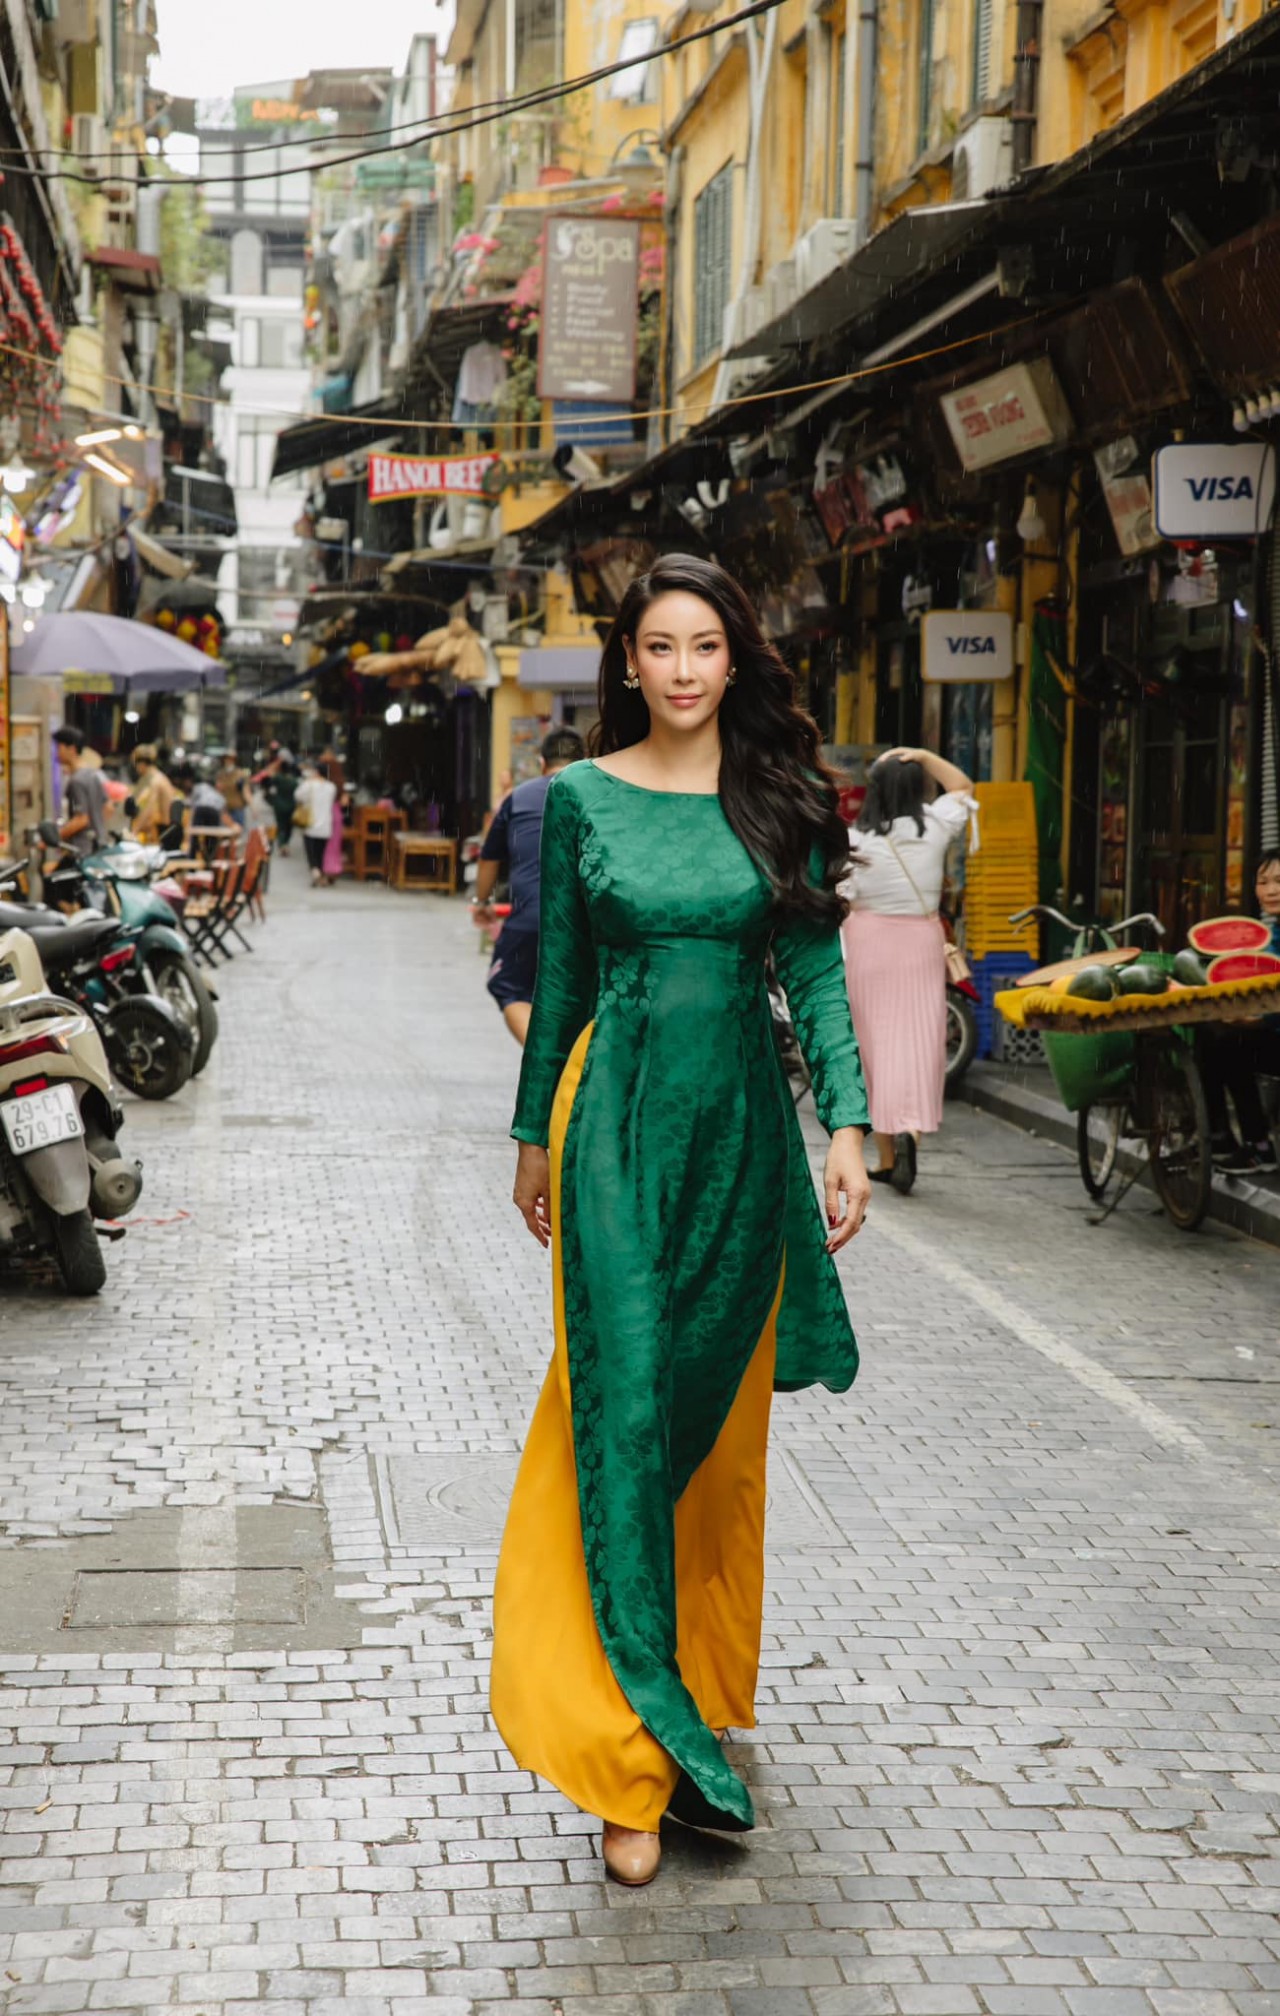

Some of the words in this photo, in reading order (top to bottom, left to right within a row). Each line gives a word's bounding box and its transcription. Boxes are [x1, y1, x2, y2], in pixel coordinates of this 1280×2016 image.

[373, 457, 441, 494] HANOI
[1183, 475, 1254, 502] VISA
[945, 635, 996, 655] VISA
[11, 1091, 63, 1124] 29-C1
[13, 1112, 78, 1148] 679.76
